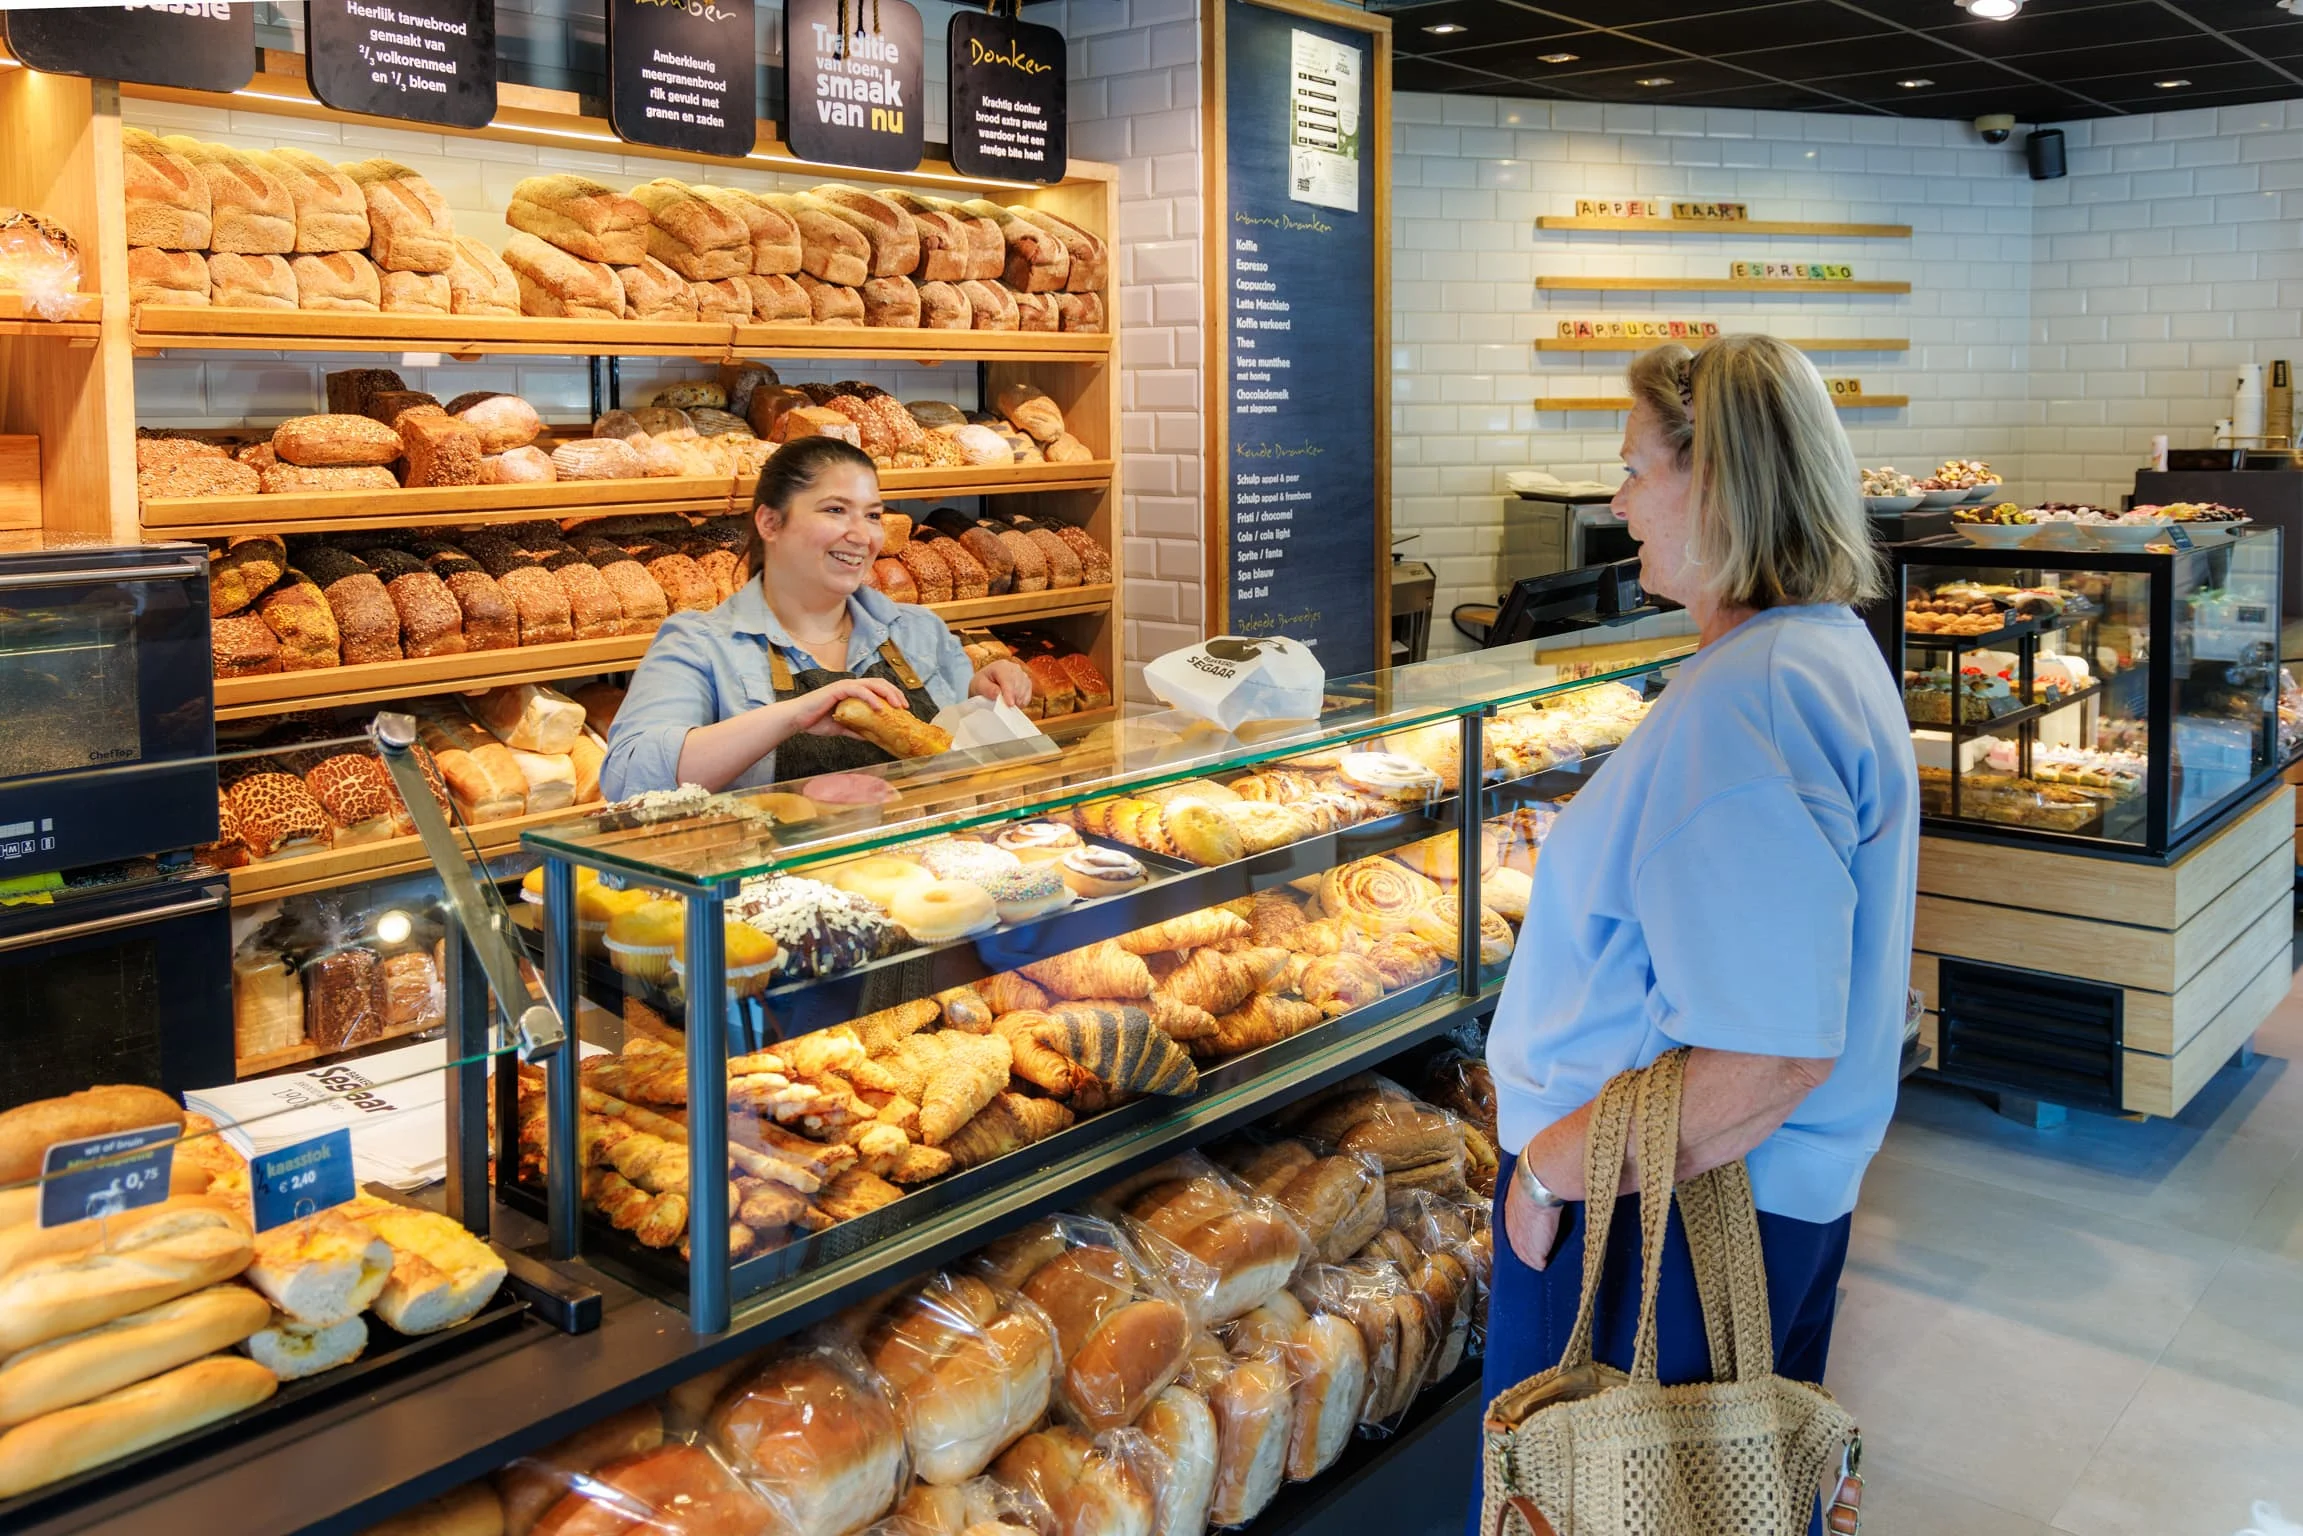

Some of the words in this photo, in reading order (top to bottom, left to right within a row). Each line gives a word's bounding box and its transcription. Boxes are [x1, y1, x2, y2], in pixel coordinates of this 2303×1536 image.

[346, 0, 395, 22] Heerlijk
[398, 12, 467, 36] tarwebrood
[370, 29, 422, 48] gemaakt
[424, 38, 446, 52] van
[376, 51, 457, 74] volkorenmeel
[653, 49, 716, 74] Amberkleurig
[971, 38, 1052, 74] Donker
[816, 56, 842, 73] van
[847, 61, 882, 81] toen,
[372, 71, 388, 84] en
[409, 74, 447, 93] bloem
[641, 68, 727, 93] meergranenbrood
[816, 68, 903, 107] smaak
[650, 87, 666, 101] rijk
[668, 91, 700, 107] gevuld
[702, 97, 720, 109] met
[982, 95, 1013, 112] Krachtig
[1014, 101, 1041, 115] donker
[646, 106, 680, 122] granen
[682, 112, 694, 124] en
[696, 114, 725, 128] zaden
[816, 99, 864, 128] van
[871, 107, 904, 134] nu
[975, 110, 1001, 124] brood
[1001, 115, 1021, 128] extra
[1022, 119, 1048, 132] gevuld
[978, 129, 1016, 143] waardoor
[1017, 132, 1029, 144] het
[1030, 136, 1045, 147] een
[979, 143, 1007, 157] stevige
[1008, 146, 1023, 159] bite
[1024, 149, 1044, 161] heeft
[1582, 202, 1656, 217] APPEL
[1677, 204, 1746, 219] TAART
[1282, 212, 1333, 233] Dranken
[1236, 238, 1258, 252] Koffie
[1236, 258, 1269, 272] Espresso
[1736, 263, 1852, 279] ESPRESSO
[1236, 277, 1276, 292] Cappuccino
[1236, 297, 1255, 310] Latte
[1256, 298, 1290, 312] Macchiato
[1236, 316, 1258, 329] Koffie
[1259, 318, 1291, 330] verkeerd
[1561, 321, 1718, 337] CAPPUCCINO
[1236, 336, 1256, 349] Thee
[1236, 355, 1257, 368] Verse
[1257, 357, 1291, 369] muntthee
[1236, 372, 1249, 381] met
[1249, 371, 1271, 382] honing
[1236, 388, 1289, 401] Chocolademelk
[1236, 404, 1249, 414] met
[1249, 403, 1278, 415] slagroom
[1237, 473, 1260, 485] Schulp
[1261, 473, 1279, 485] appel
[1237, 492, 1260, 505] Schulp
[1261, 492, 1279, 504] appel
[1285, 490, 1312, 502] framboos
[1237, 511, 1255, 524] Fristi
[1261, 508, 1293, 522] chocomel
[1237, 530, 1254, 543] Cola
[1259, 528, 1274, 541] cola
[1275, 527, 1291, 540] light
[1237, 549, 1259, 563] Sprite
[1265, 547, 1283, 559] fanta
[1237, 568, 1252, 582] Spa
[1253, 567, 1275, 579] blauw
[1237, 587, 1253, 600] Red
[1254, 585, 1269, 598] Bull
[1187, 656, 1236, 679] SEGAAR
[90, 749, 134, 761] ChefTop
[272, 1088, 312, 1108] 190
[306, 1066, 398, 1113] Segaar
[266, 1144, 331, 1179] kaasstok
[126, 1167, 159, 1191] 0,75
[279, 1180, 289, 1194] €
[291, 1169, 317, 1191] 2,40
